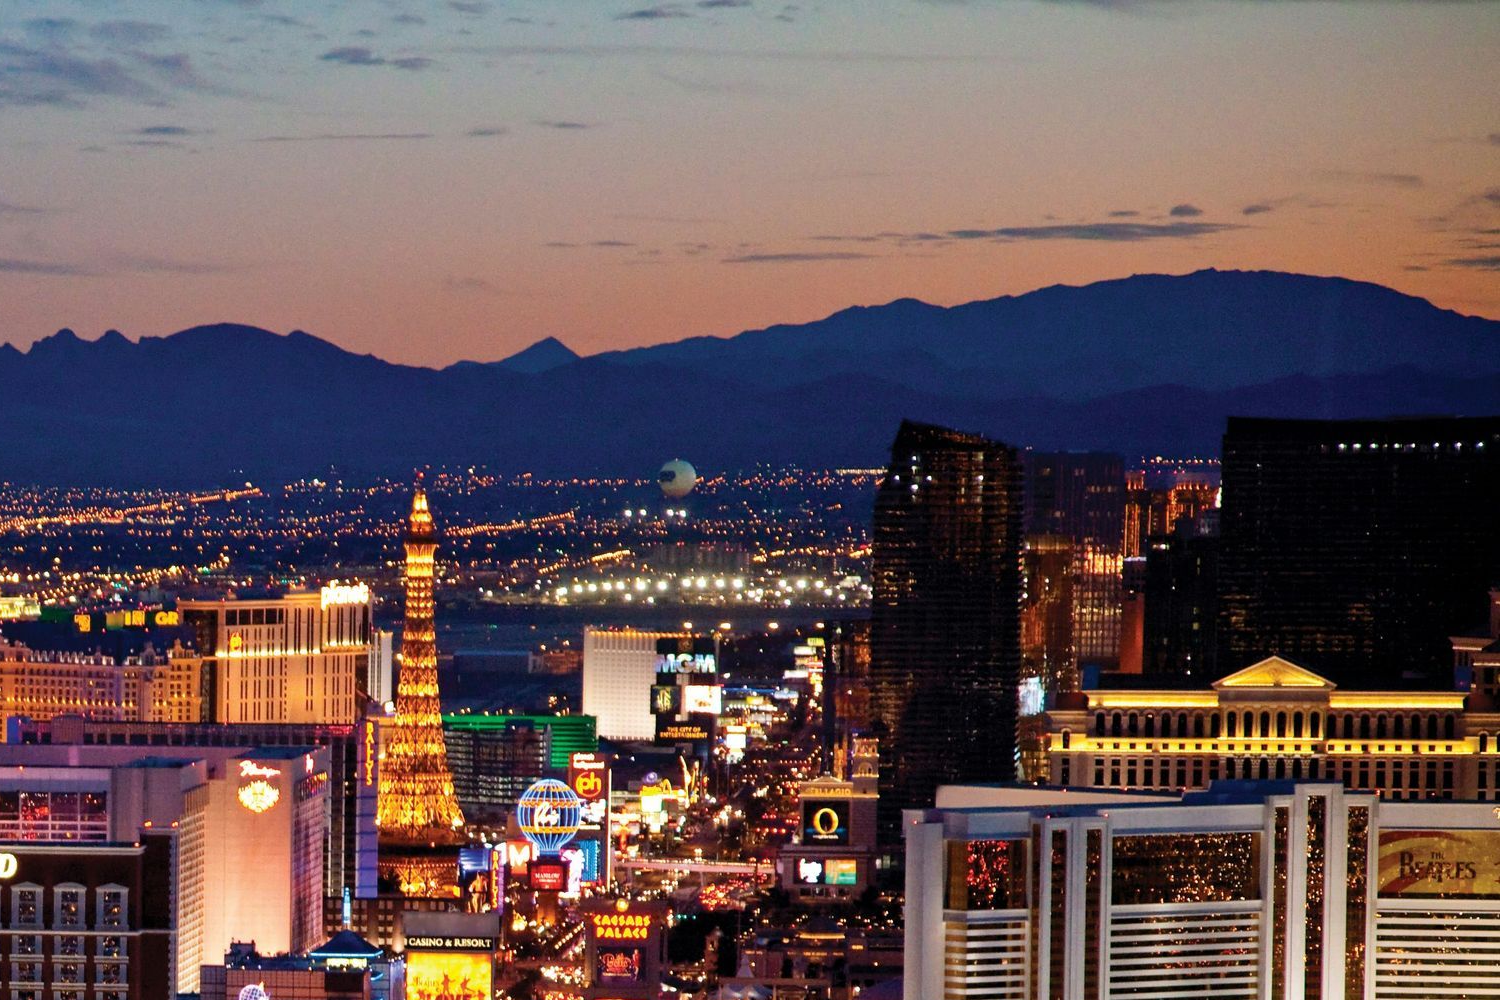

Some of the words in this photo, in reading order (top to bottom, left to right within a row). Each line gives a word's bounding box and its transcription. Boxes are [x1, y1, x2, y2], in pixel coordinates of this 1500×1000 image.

[654, 653, 716, 673] MGM
[1399, 851, 1477, 882] BEATLES
[594, 914, 651, 927] CAESARS
[596, 927, 648, 939] PALACE
[408, 937, 443, 948] CASINO
[444, 939, 453, 948] &
[454, 937, 492, 948] RESORT
